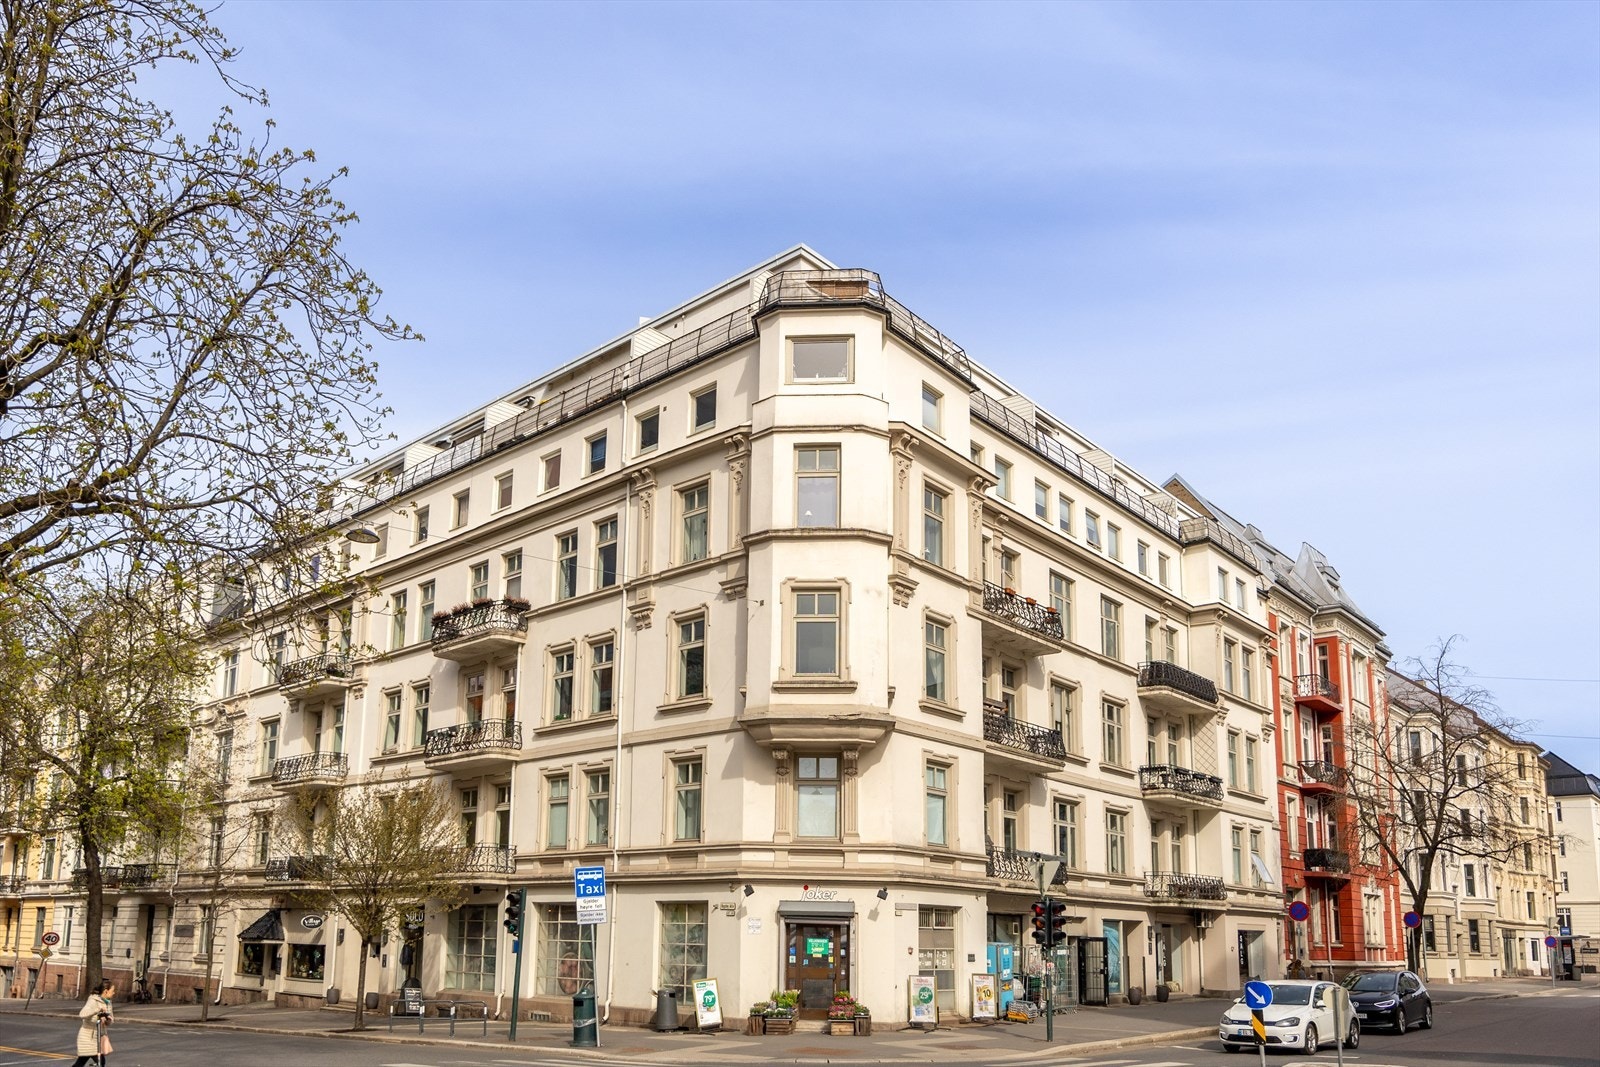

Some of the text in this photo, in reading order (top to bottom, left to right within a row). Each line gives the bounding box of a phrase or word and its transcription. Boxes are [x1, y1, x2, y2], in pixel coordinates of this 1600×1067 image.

[578, 882, 603, 895] Taxi
[801, 884, 837, 902] joker
[45, 935, 56, 943] 40
[983, 989, 991, 998] 10
